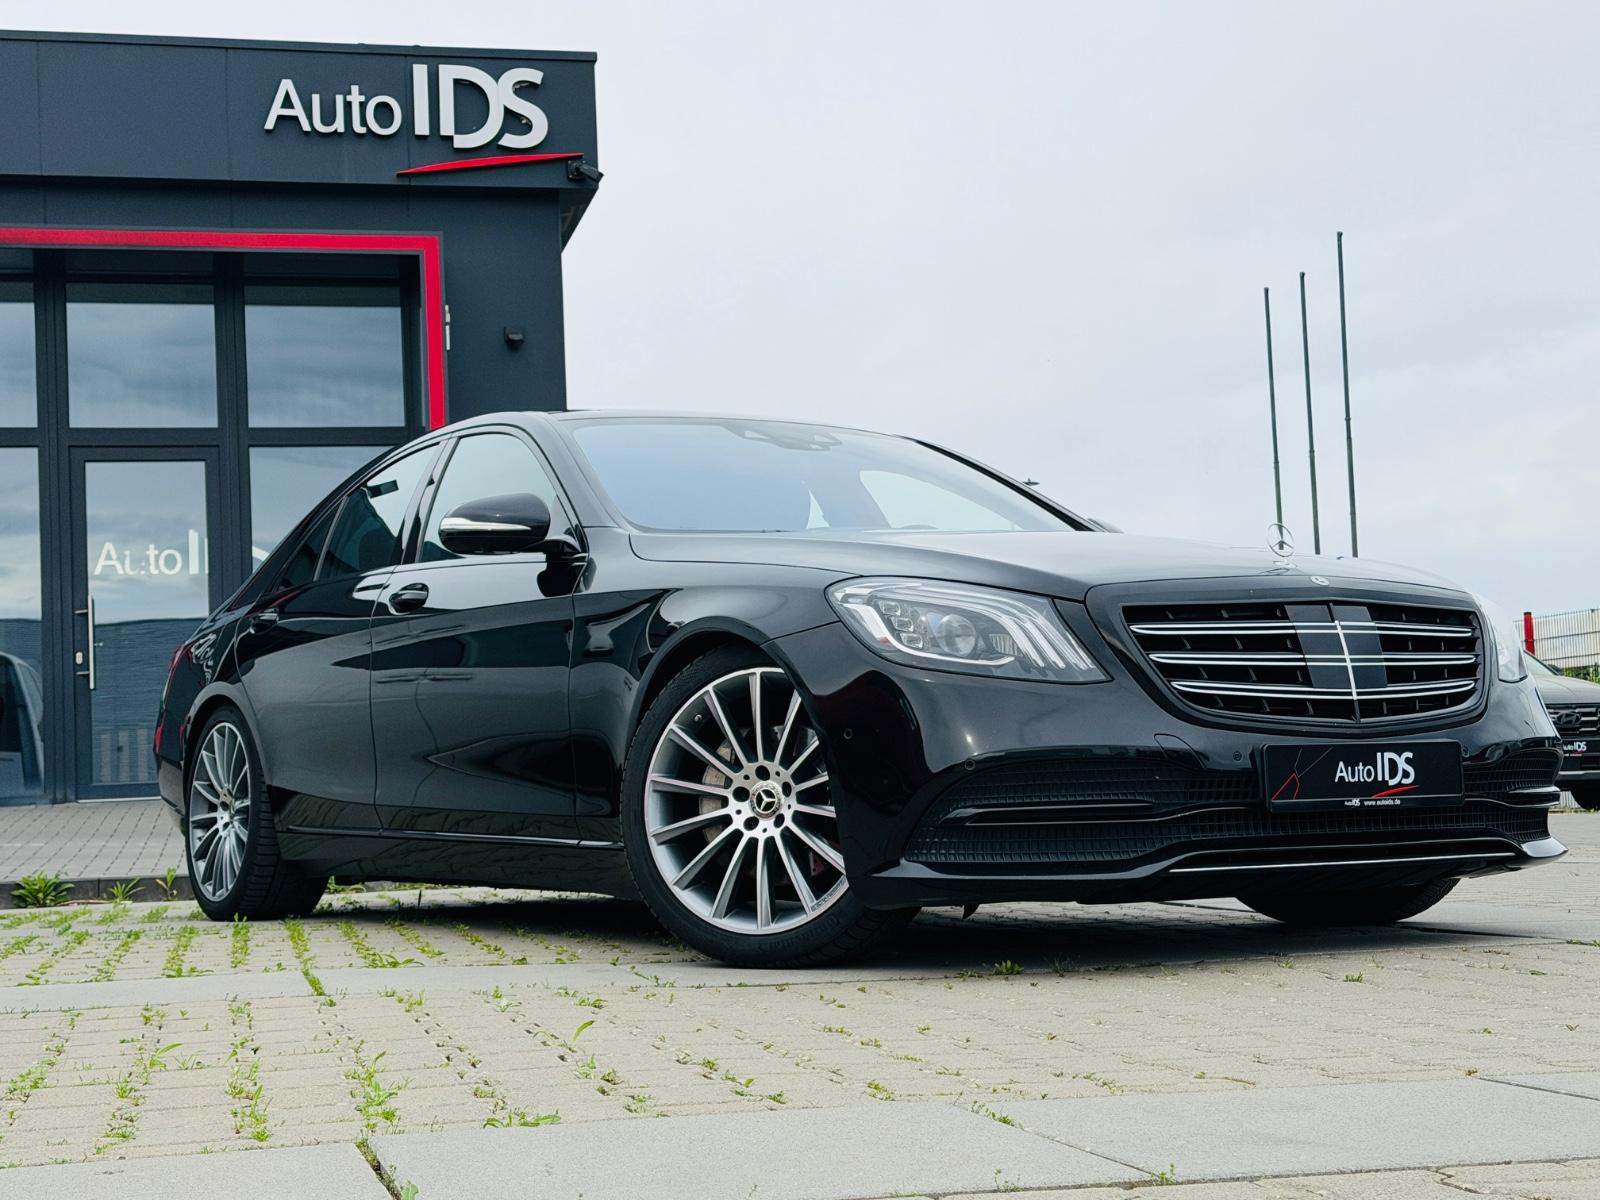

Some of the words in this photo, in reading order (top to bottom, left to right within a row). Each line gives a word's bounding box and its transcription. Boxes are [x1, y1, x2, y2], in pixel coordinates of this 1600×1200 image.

[264, 78, 402, 136] Auto
[411, 63, 549, 149] IDS
[1334, 761, 1375, 783] Auto
[1376, 751, 1415, 786] IDS
